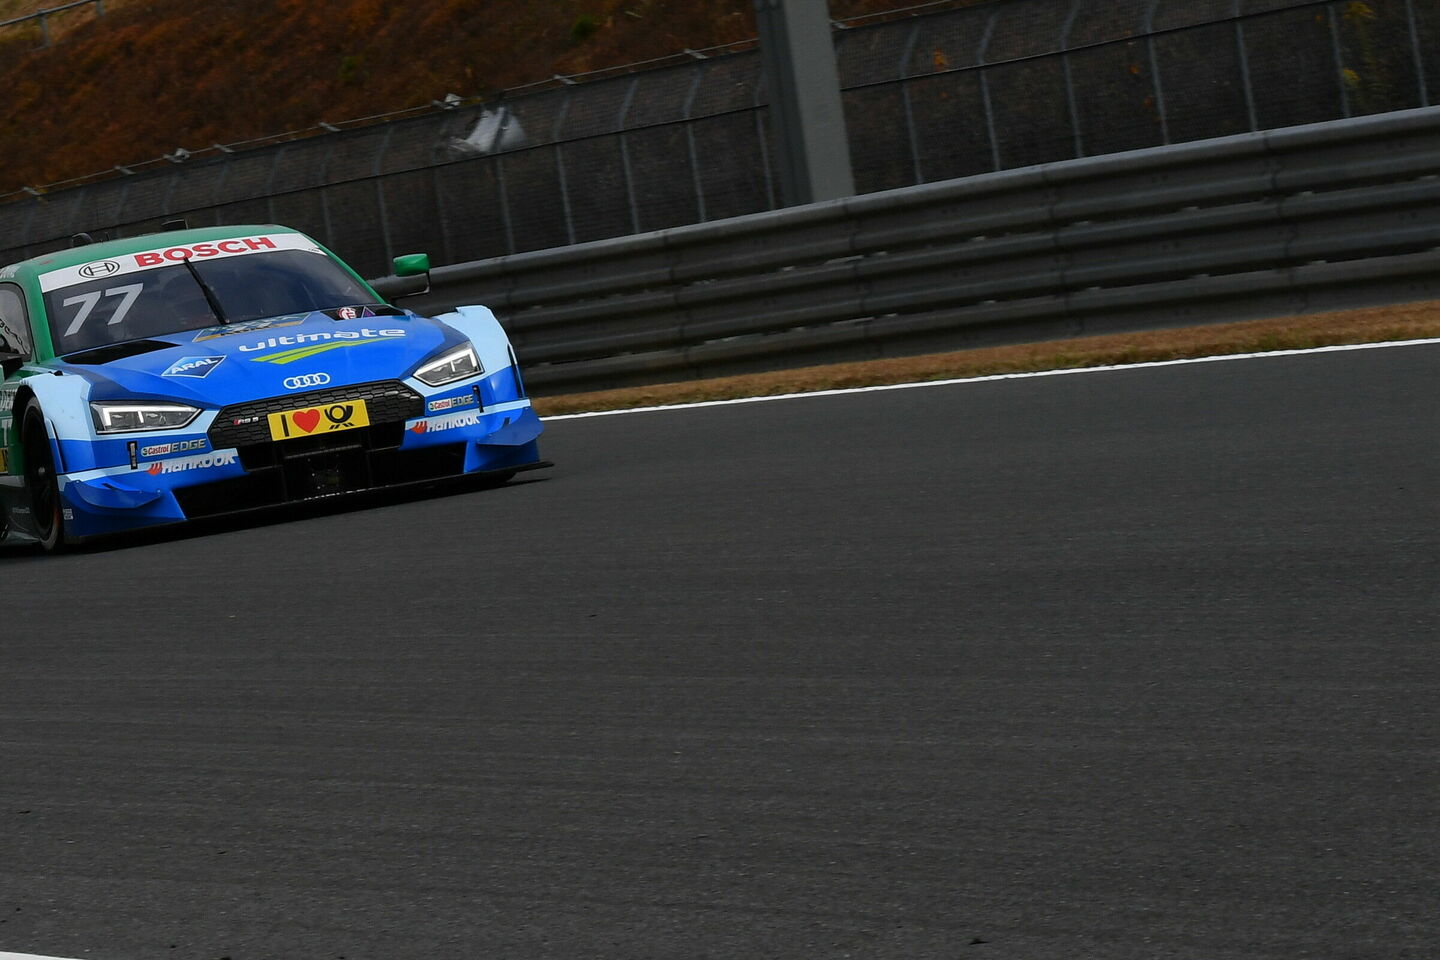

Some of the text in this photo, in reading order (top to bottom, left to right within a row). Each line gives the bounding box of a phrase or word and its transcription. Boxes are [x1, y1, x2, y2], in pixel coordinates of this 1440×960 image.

[134, 237, 276, 268] BOSCH
[62, 283, 144, 337] 77
[239, 328, 406, 352] ultimate
[171, 357, 220, 375] ARAL
[452, 394, 474, 407] EDGE
[281, 414, 290, 437] I
[147, 438, 207, 455] Castrol EDGE
